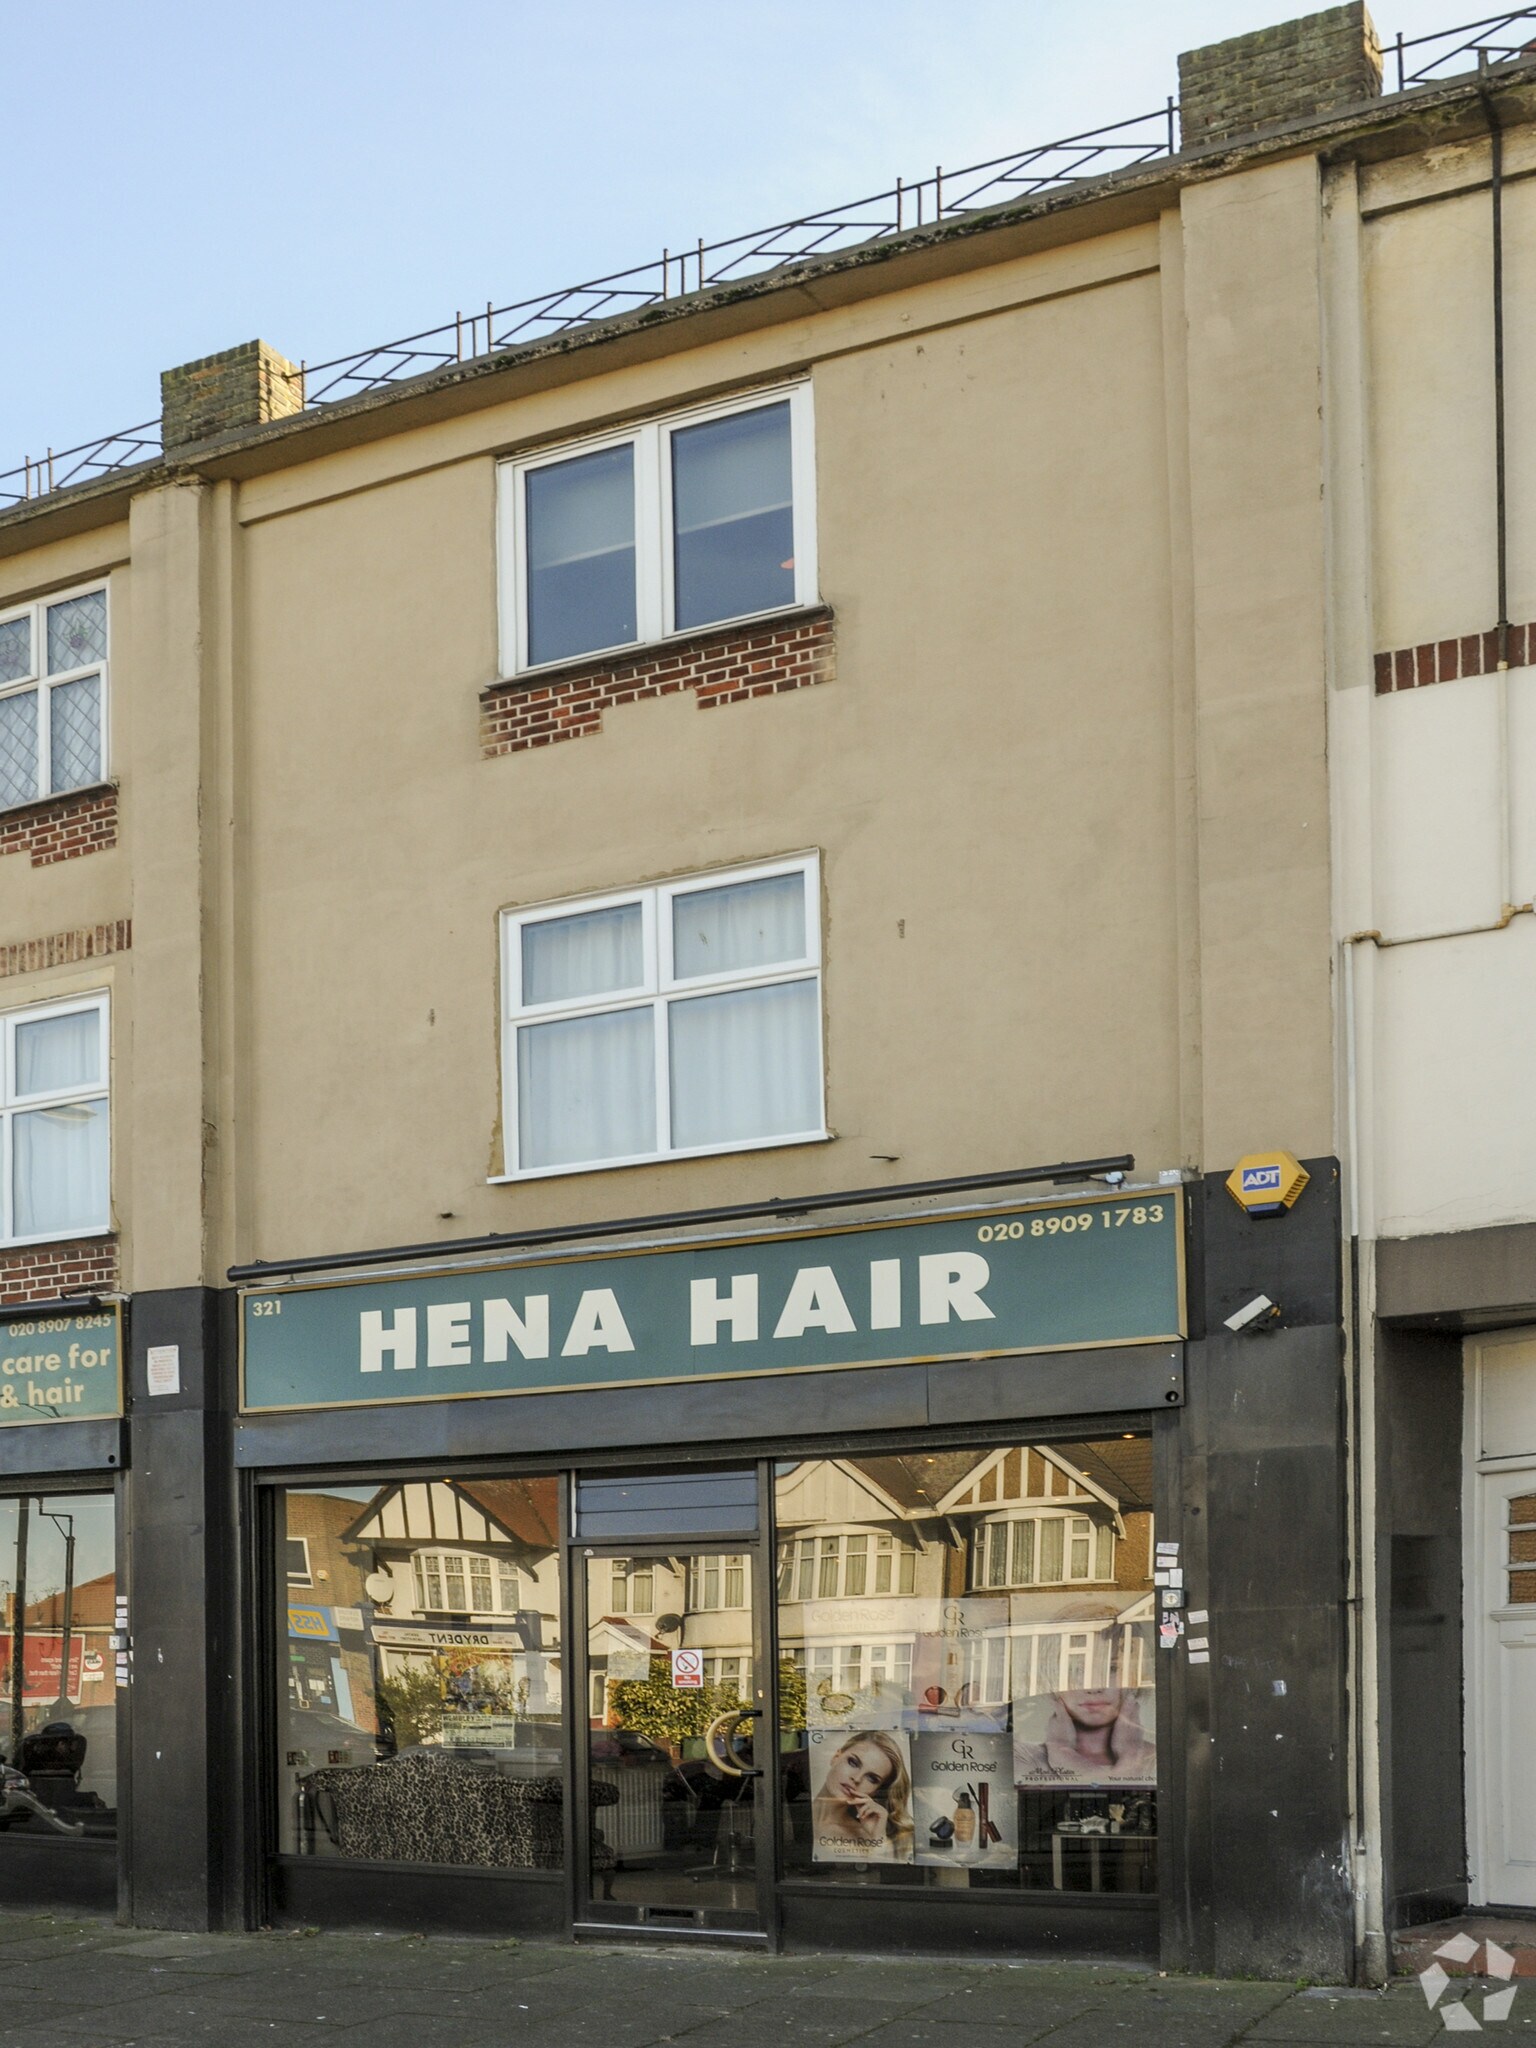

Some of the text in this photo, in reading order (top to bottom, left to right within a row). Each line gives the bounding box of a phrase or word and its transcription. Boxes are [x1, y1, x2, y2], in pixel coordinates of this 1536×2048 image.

[1243, 1169, 1280, 1187] ADT
[977, 1205, 1164, 1244] 020 8909 1783
[252, 1300, 282, 1317] 321
[360, 1251, 996, 1373] HENA HAIR
[9, 1314, 111, 1337] 020 8907 8245
[2, 1343, 111, 1375] care for
[0, 1377, 84, 1409] & hair
[811, 1607, 859, 1623] Golden
[931, 1761, 997, 1773] Golden Rose
[819, 1836, 884, 1848] Golden Rose
